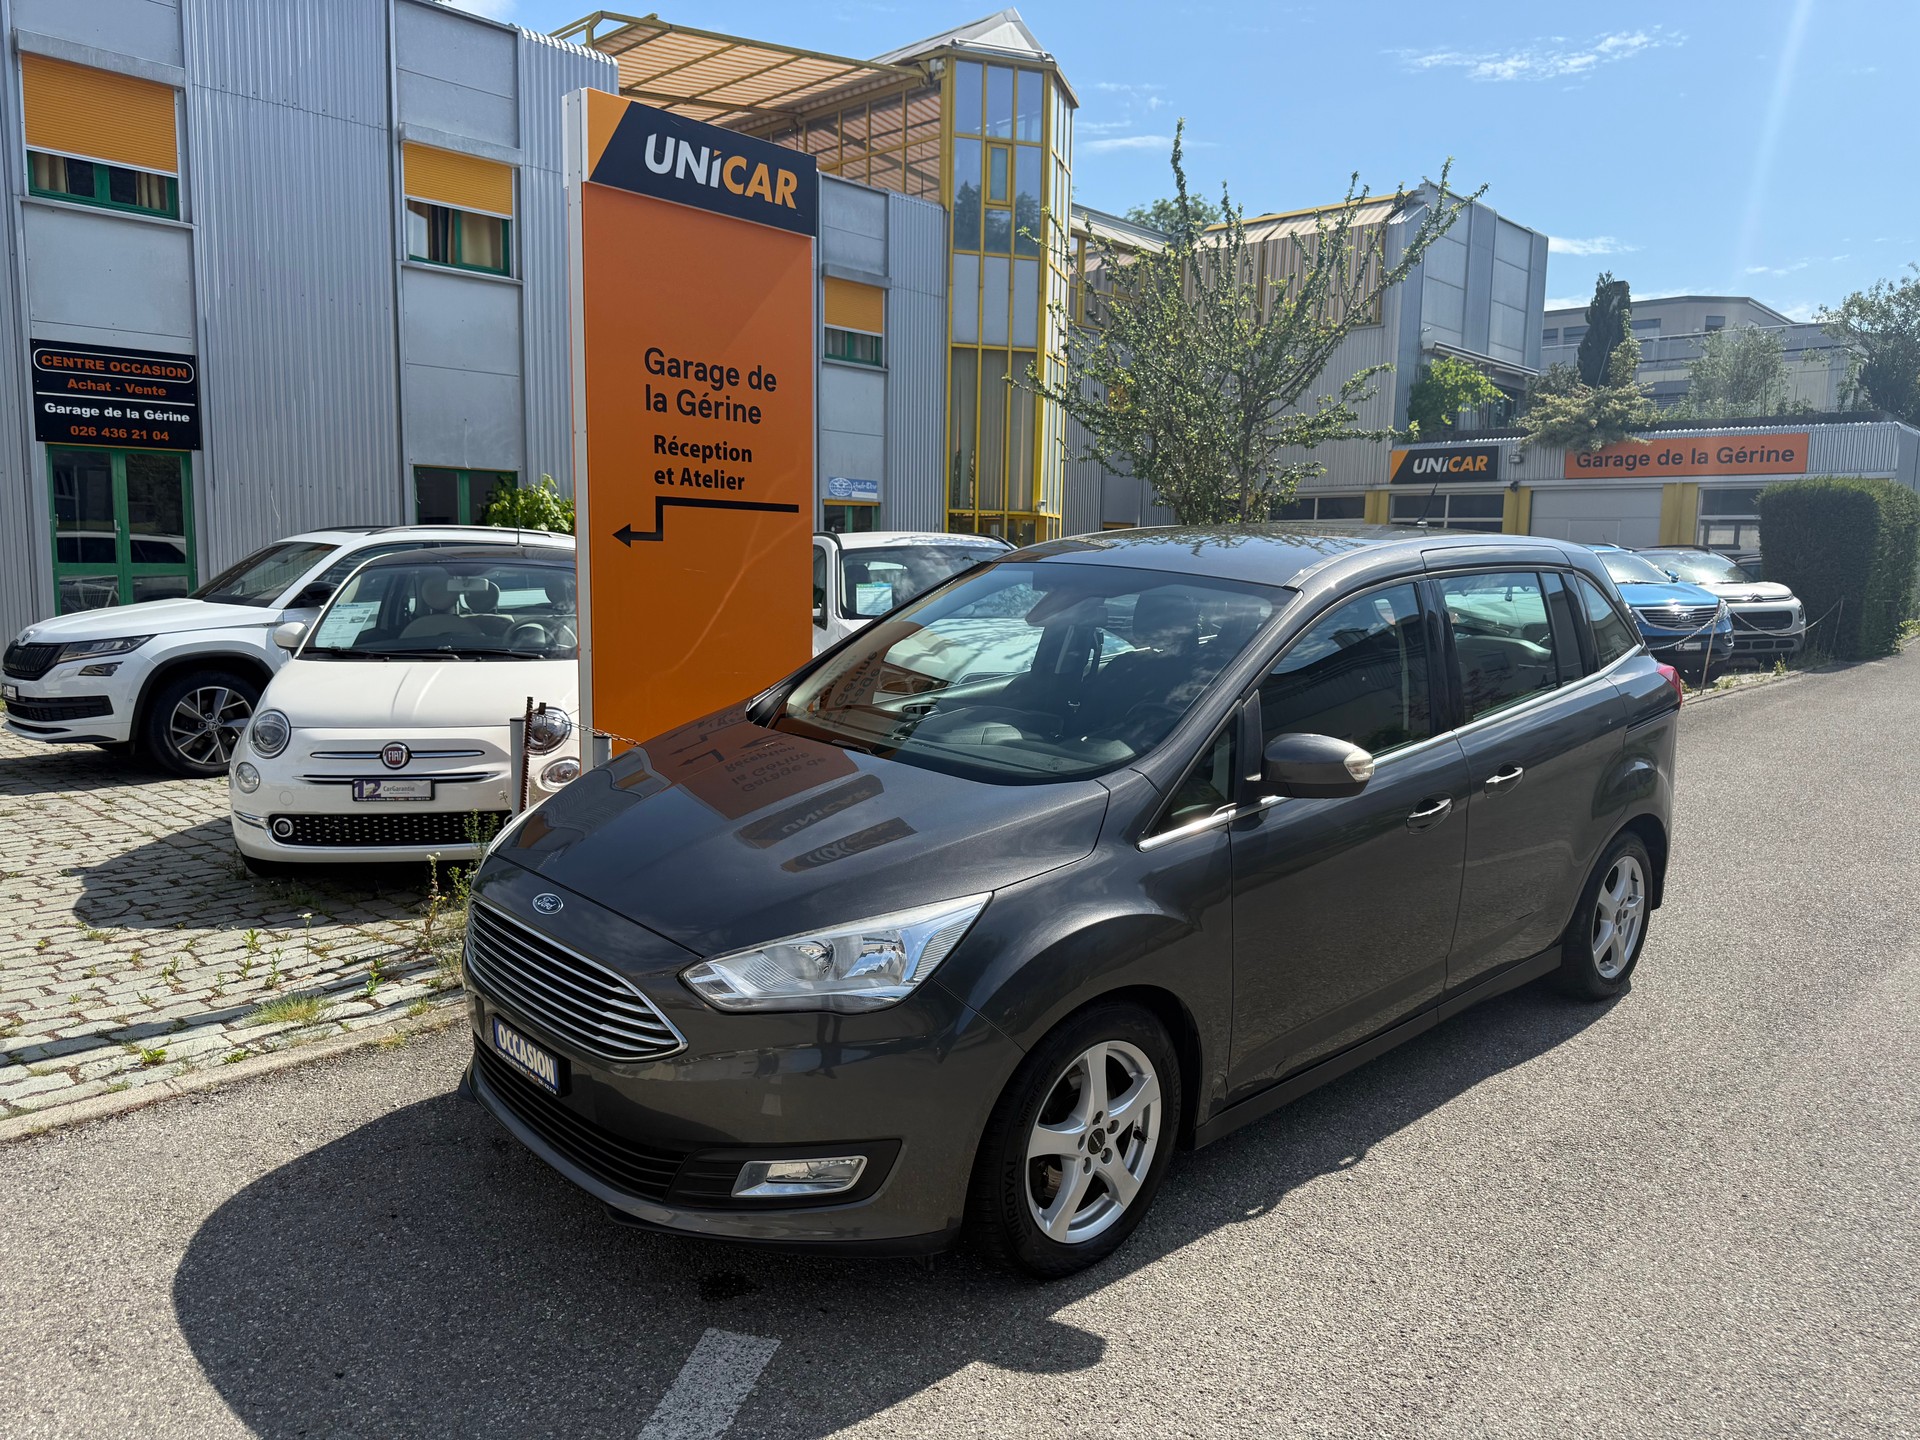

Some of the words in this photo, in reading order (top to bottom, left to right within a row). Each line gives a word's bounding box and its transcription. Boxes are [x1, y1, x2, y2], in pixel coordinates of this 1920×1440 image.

[41, 354, 105, 371] CENTRE
[109, 361, 188, 378] OCCASION
[644, 347, 740, 391] Garage
[747, 365, 777, 392] de
[67, 378, 112, 392] Achat
[124, 383, 167, 396] Vente
[44, 402, 100, 418] Garage
[104, 406, 123, 418] de
[126, 408, 140, 419] la
[143, 409, 190, 422] Gérine
[645, 384, 668, 413] la
[676, 388, 762, 424] Gérine
[70, 425, 97, 437] 026
[101, 427, 127, 438] 436
[131, 429, 148, 440] 21
[152, 430, 170, 441] 04
[653, 434, 753, 464] Réception
[1576, 452, 1651, 471] Garage
[1657, 449, 1684, 466] de
[1691, 448, 1709, 465] la
[1716, 446, 1795, 464] Gérine
[654, 467, 675, 485] et
[680, 467, 745, 491] Atelier
[388, 750, 402, 761] FIAT
[354, 780, 381, 797] 12
[498, 1024, 555, 1086] OCCASION
